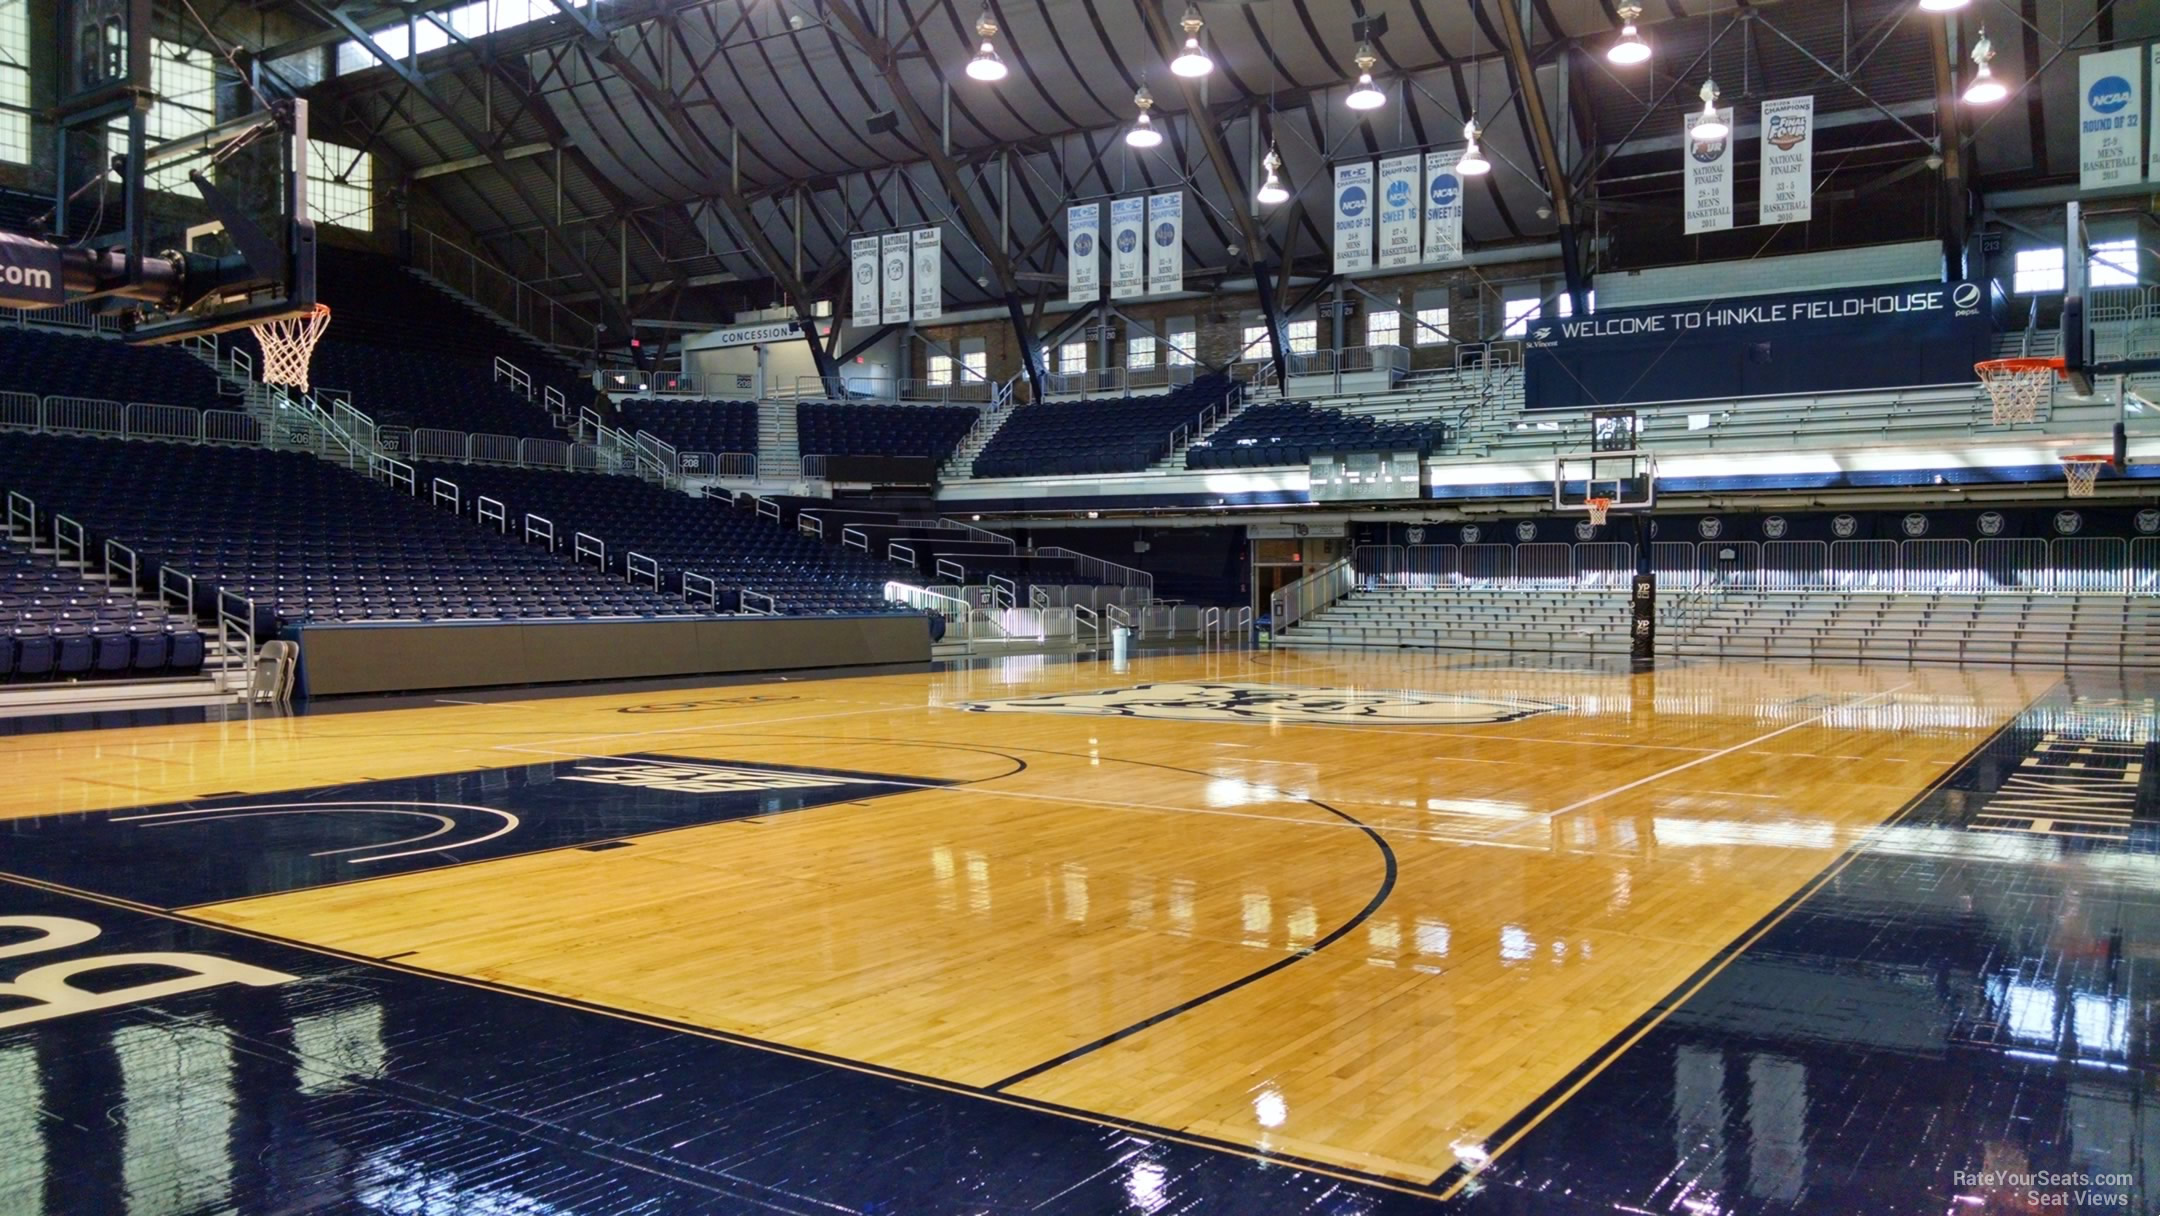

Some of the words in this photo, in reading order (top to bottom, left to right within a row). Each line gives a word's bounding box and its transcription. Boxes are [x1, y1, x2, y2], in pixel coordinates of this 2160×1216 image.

[2092, 91, 2131, 107] NCAA
[1764, 104, 1810, 115] CHAMPIONS
[2083, 118, 2112, 133] ROUND
[2114, 117, 2125, 129] OF
[2127, 114, 2138, 127] 32
[1769, 153, 1804, 165] NATIONAL
[2083, 156, 2138, 171] BASKETBALL
[1381, 166, 1417, 177] CHAMPIONS
[1693, 164, 1724, 176] NATIONAL
[1771, 164, 1802, 175] FINALIST
[1694, 174, 1722, 185] FINALIST
[1342, 200, 1367, 210] NCAA
[1763, 200, 1808, 213] BASKETBALL
[1382, 209, 1404, 223] SWEET
[1408, 208, 1417, 219] 16
[1428, 207, 1452, 220] SWEET
[1687, 206, 1730, 219] BASKETBALL
[1701, 219, 1716, 228] 2011
[1382, 245, 1417, 257] BASKETBALL
[1562, 316, 1665, 338] WELCOME
[1671, 312, 1701, 330] TO
[1707, 304, 1786, 327] HINKLE
[1793, 292, 1944, 320] FIELDHOUSE
[1955, 308, 1980, 317] pepsi
[290, 433, 309, 443] 206
[383, 440, 399, 450] 207
[682, 459, 699, 468] 208
